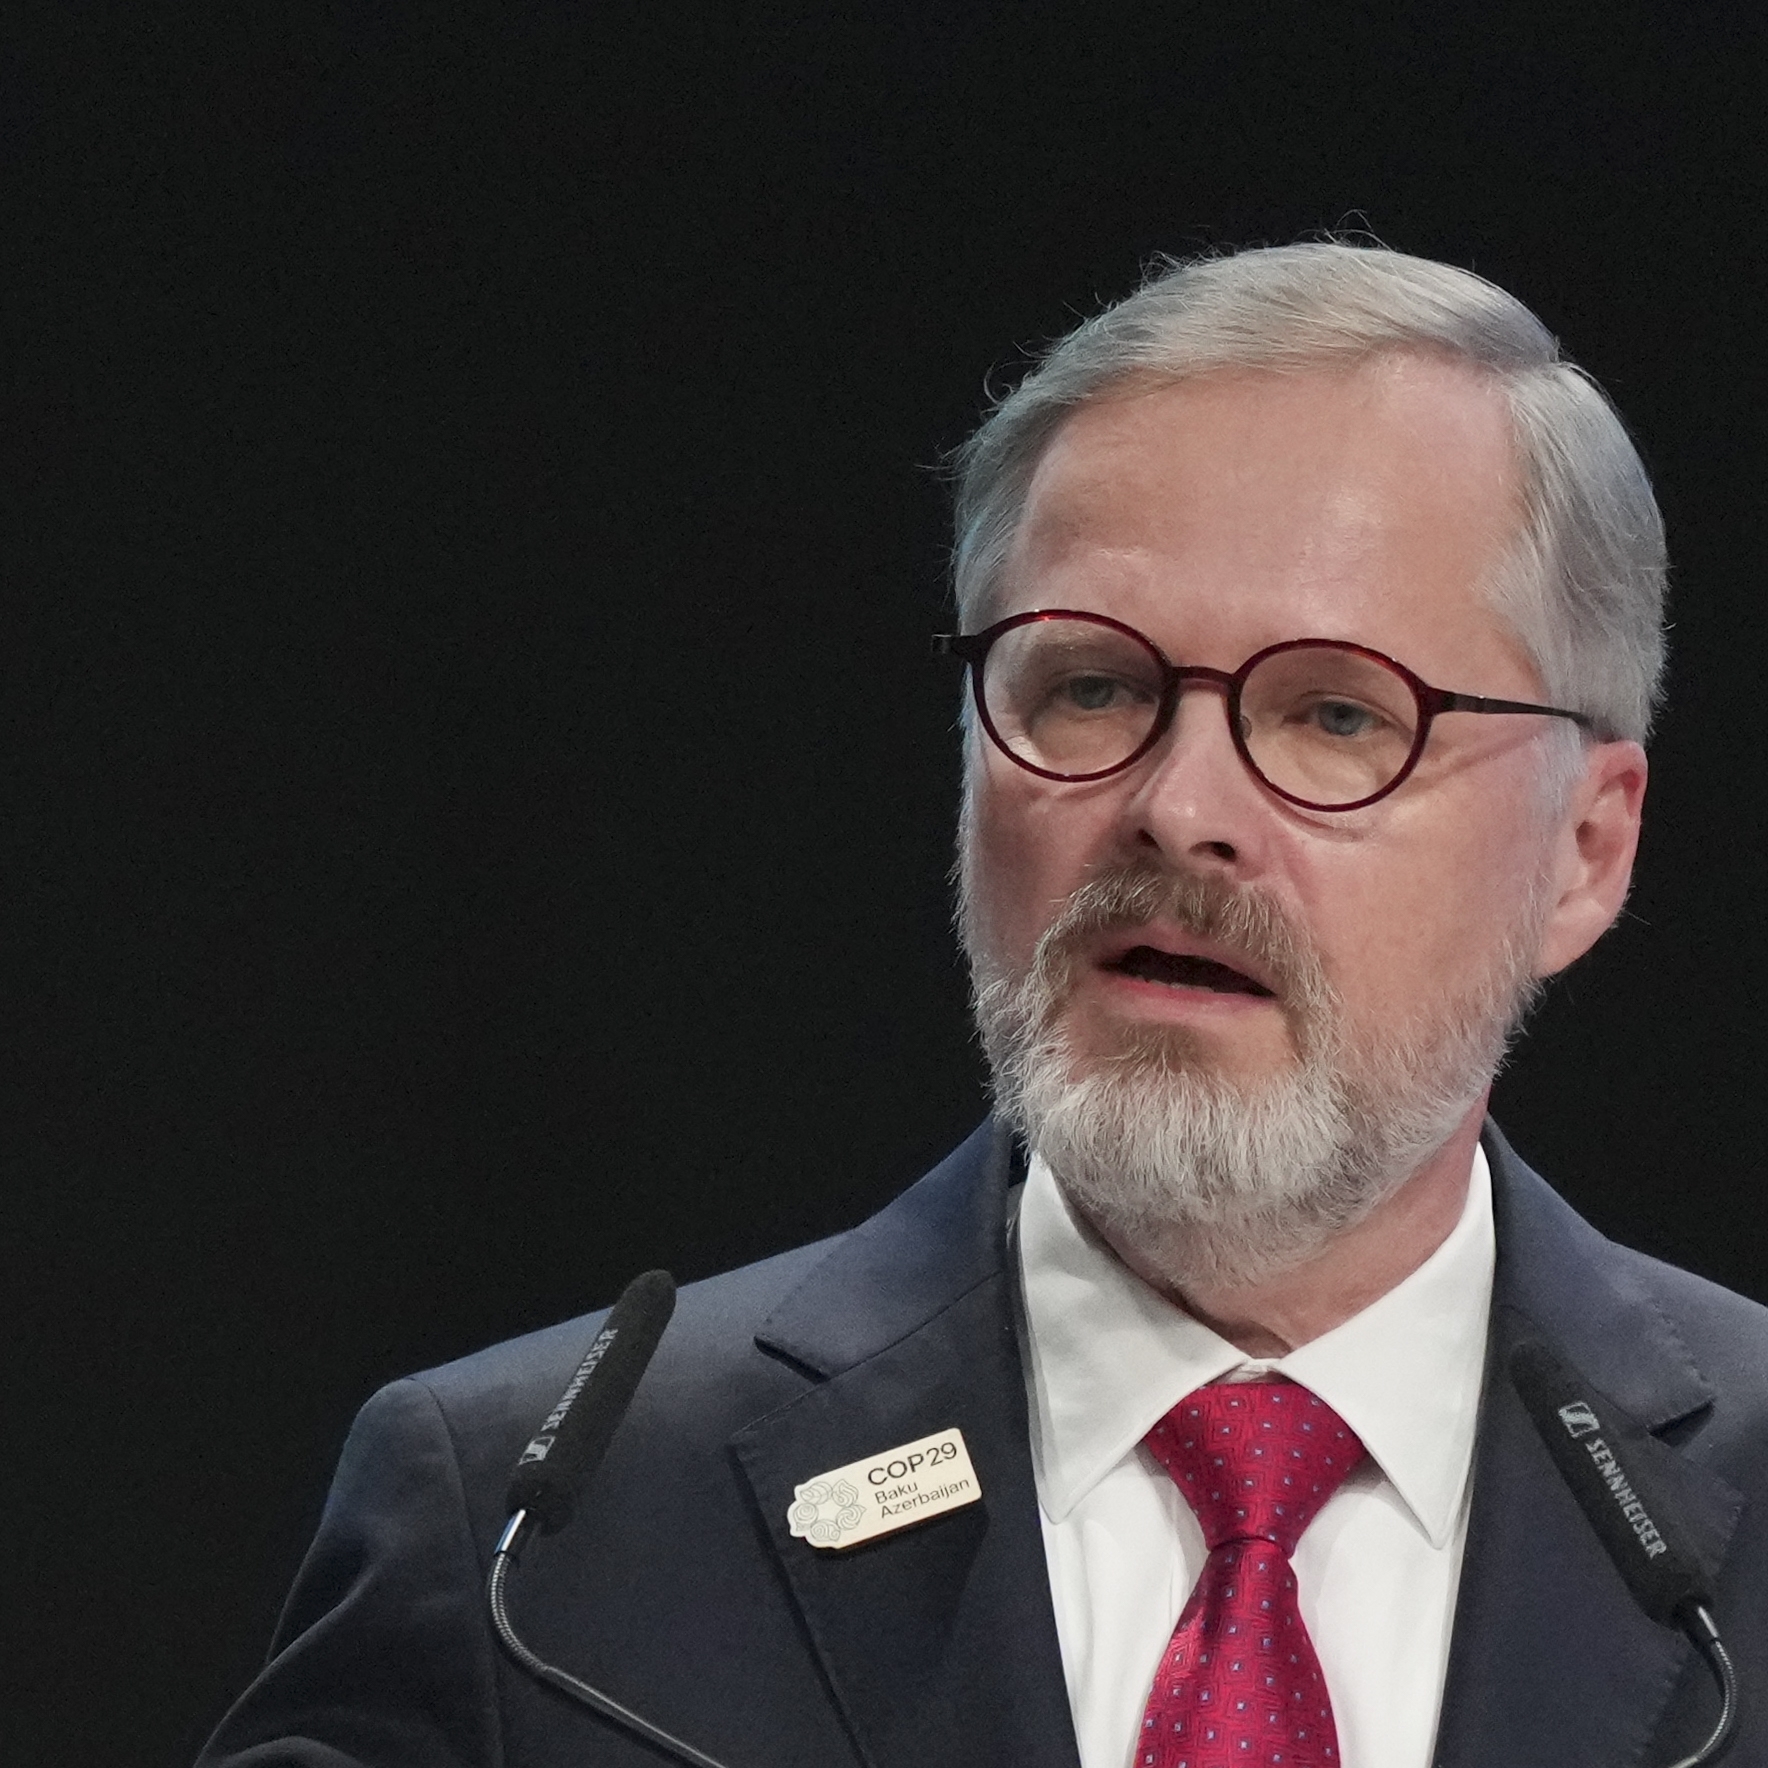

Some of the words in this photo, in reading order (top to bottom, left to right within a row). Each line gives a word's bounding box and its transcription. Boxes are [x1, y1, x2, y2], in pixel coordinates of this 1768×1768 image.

[867, 1441, 958, 1486] COP29
[874, 1481, 919, 1505] Baku
[881, 1478, 971, 1520] Azerbaijan
[1585, 1437, 1668, 1560] SENNHEISER
